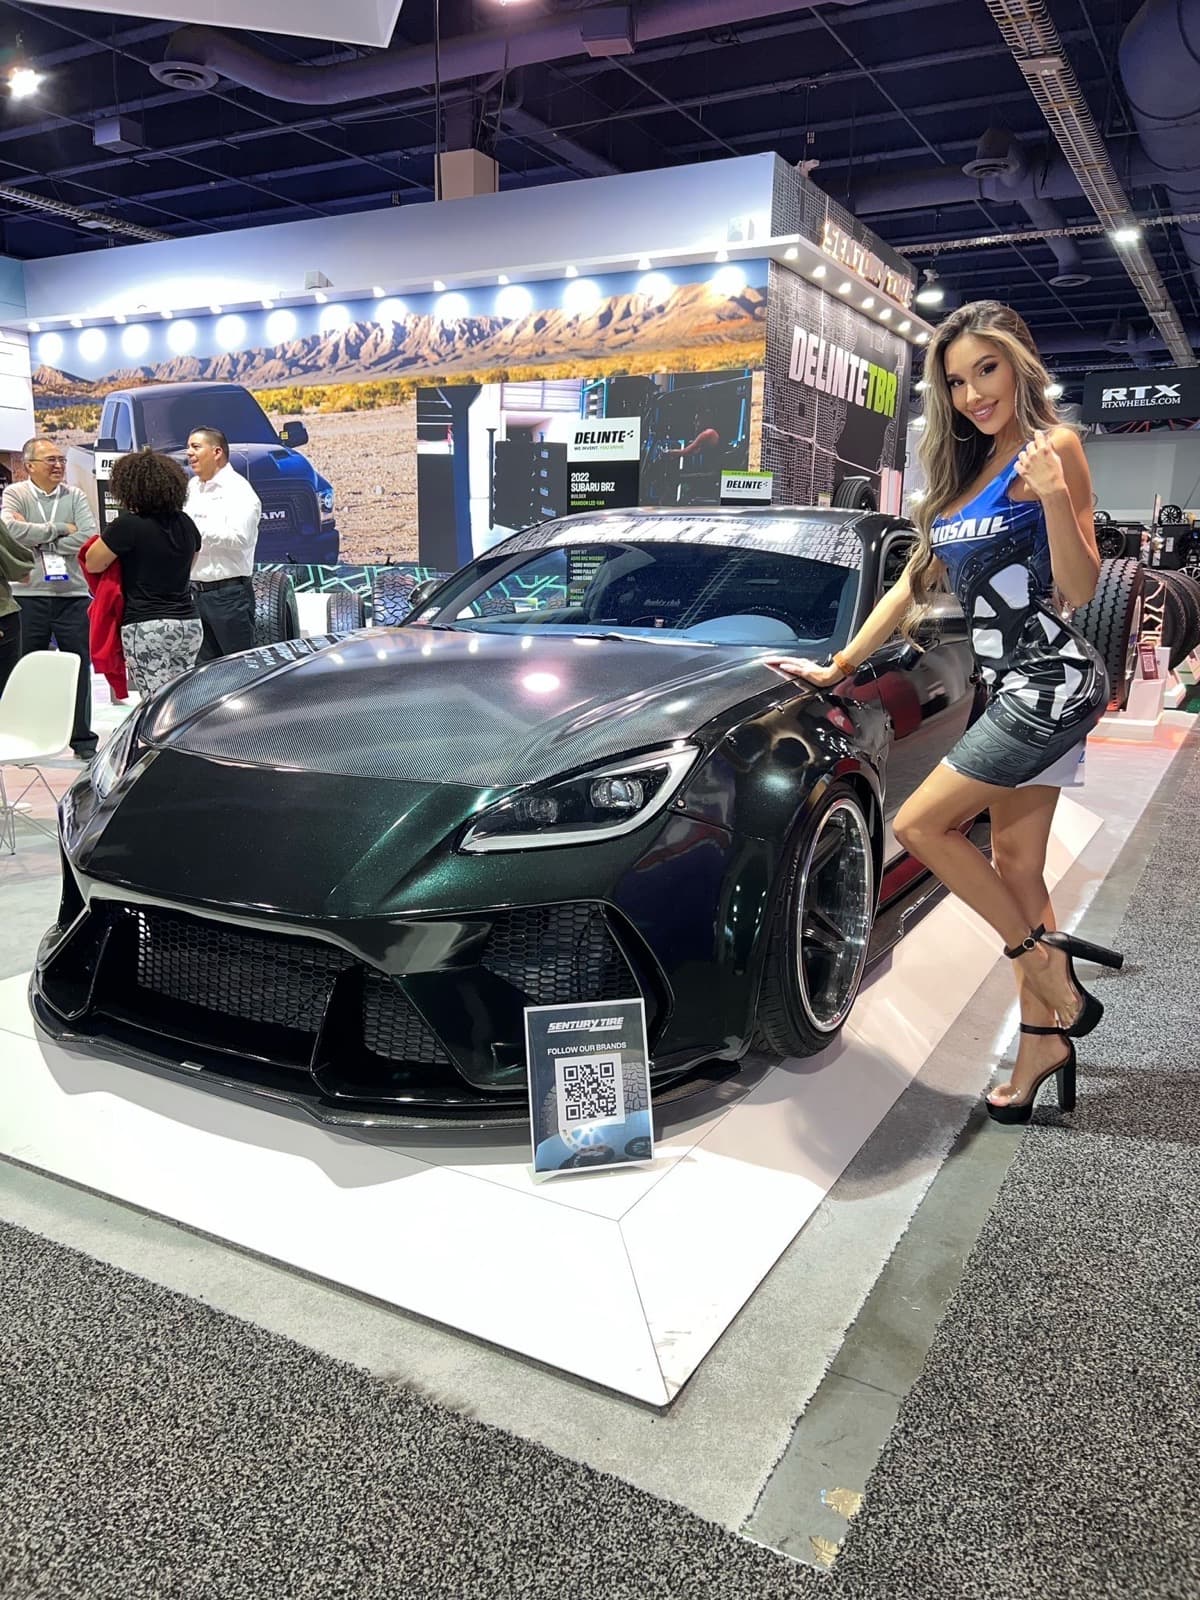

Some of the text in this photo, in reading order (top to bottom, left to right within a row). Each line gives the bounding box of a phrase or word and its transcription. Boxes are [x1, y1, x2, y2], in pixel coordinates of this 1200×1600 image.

[1102, 384, 1181, 401] RTX
[1101, 397, 1181, 409] RTXWHEELS.COM
[574, 430, 626, 445] DELINTE
[570, 472, 590, 482] 2022
[570, 482, 615, 492] SUBARU BRZ
[726, 480, 762, 489] DELINTE
[261, 510, 286, 520] AM
[548, 1016, 624, 1031] SENTURY TIRE
[547, 1041, 627, 1056] FOLLOW OUR BRANDS
